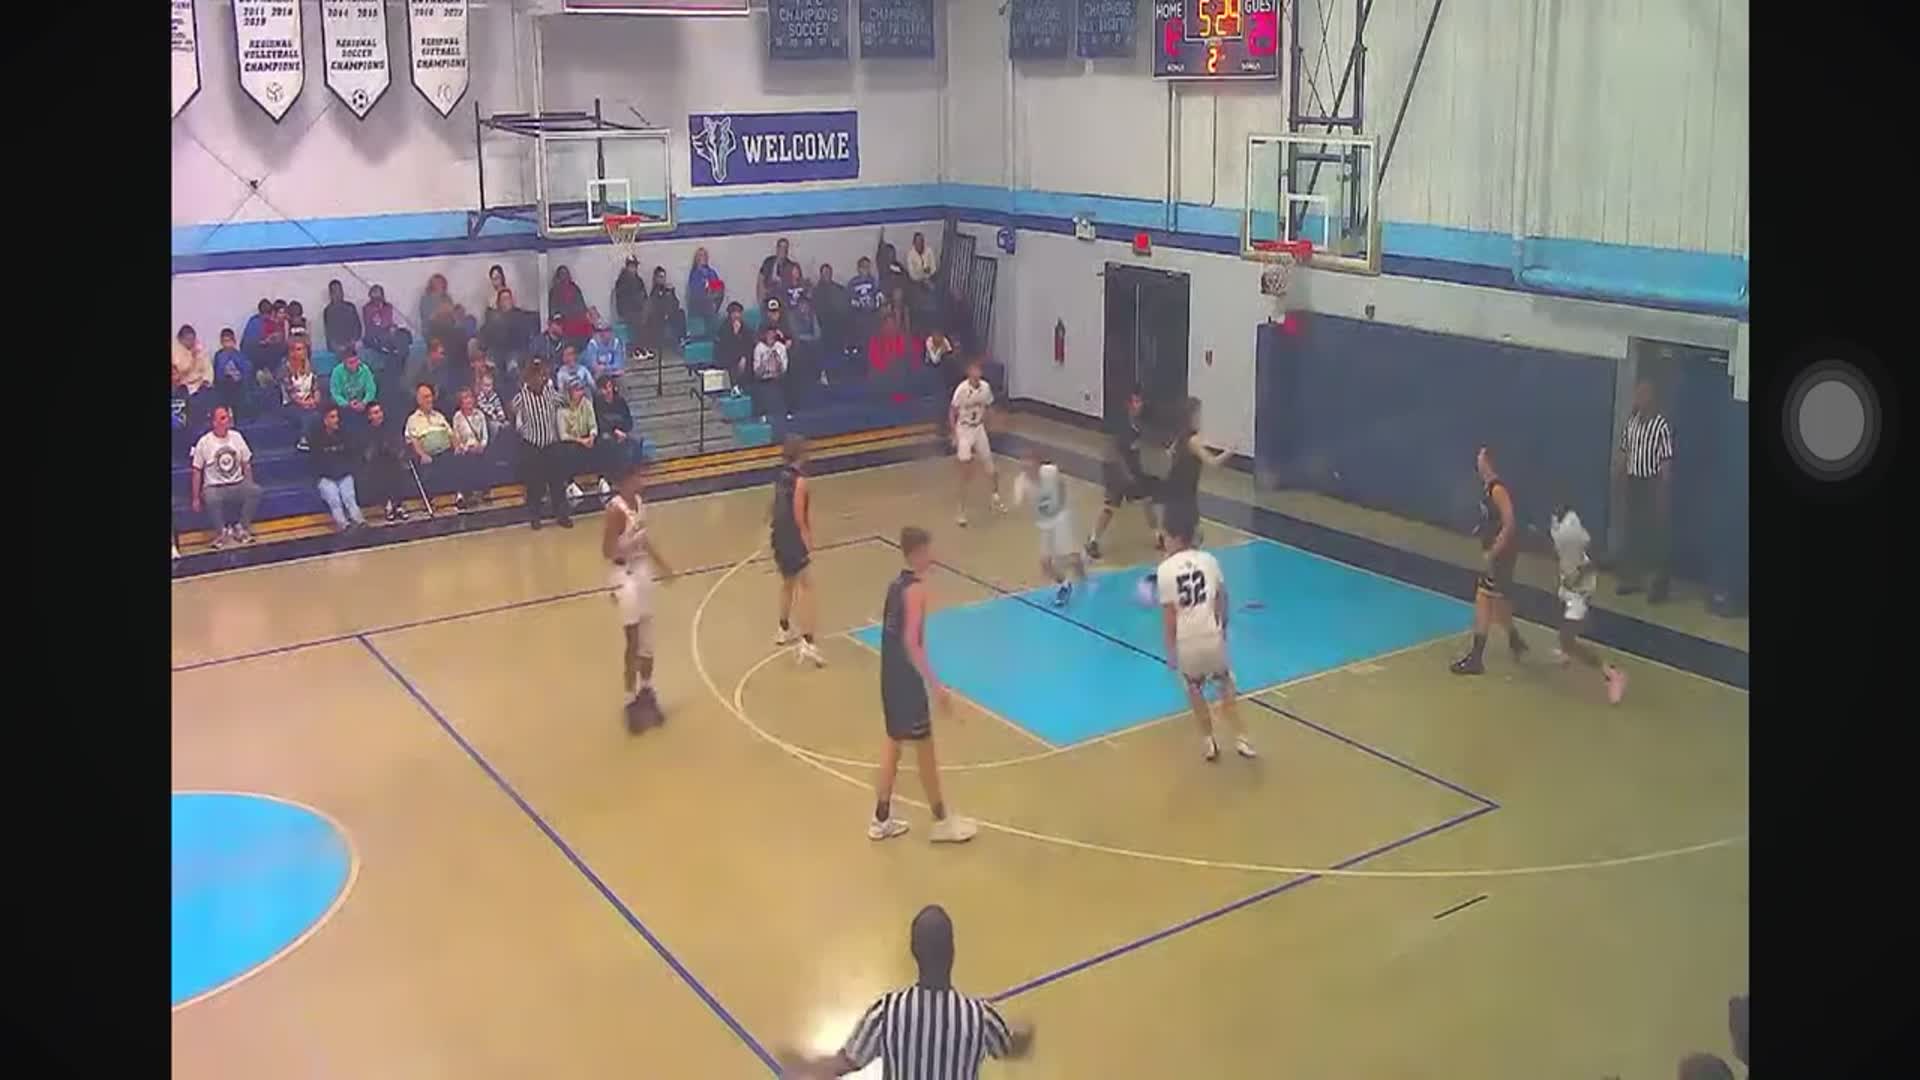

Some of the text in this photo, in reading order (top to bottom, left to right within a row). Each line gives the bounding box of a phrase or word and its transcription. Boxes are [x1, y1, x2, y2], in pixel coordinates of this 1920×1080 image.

[1157, 0, 1276, 18] HOME GUEST
[788, 23, 829, 37] SOCCER
[249, 39, 293, 48] REGIONAL
[336, 39, 377, 48] REGIONAL
[244, 50, 299, 59] VOLLEYBALL
[341, 49, 373, 58] SOCCER
[330, 60, 385, 71] CHAMPIONS
[416, 59, 466, 69] CHAMPIONS
[1207, 48, 1218, 74] 2
[244, 62, 300, 72] CHAMPIONS
[742, 131, 850, 164] WELCOME
[1176, 569, 1208, 608] 52
